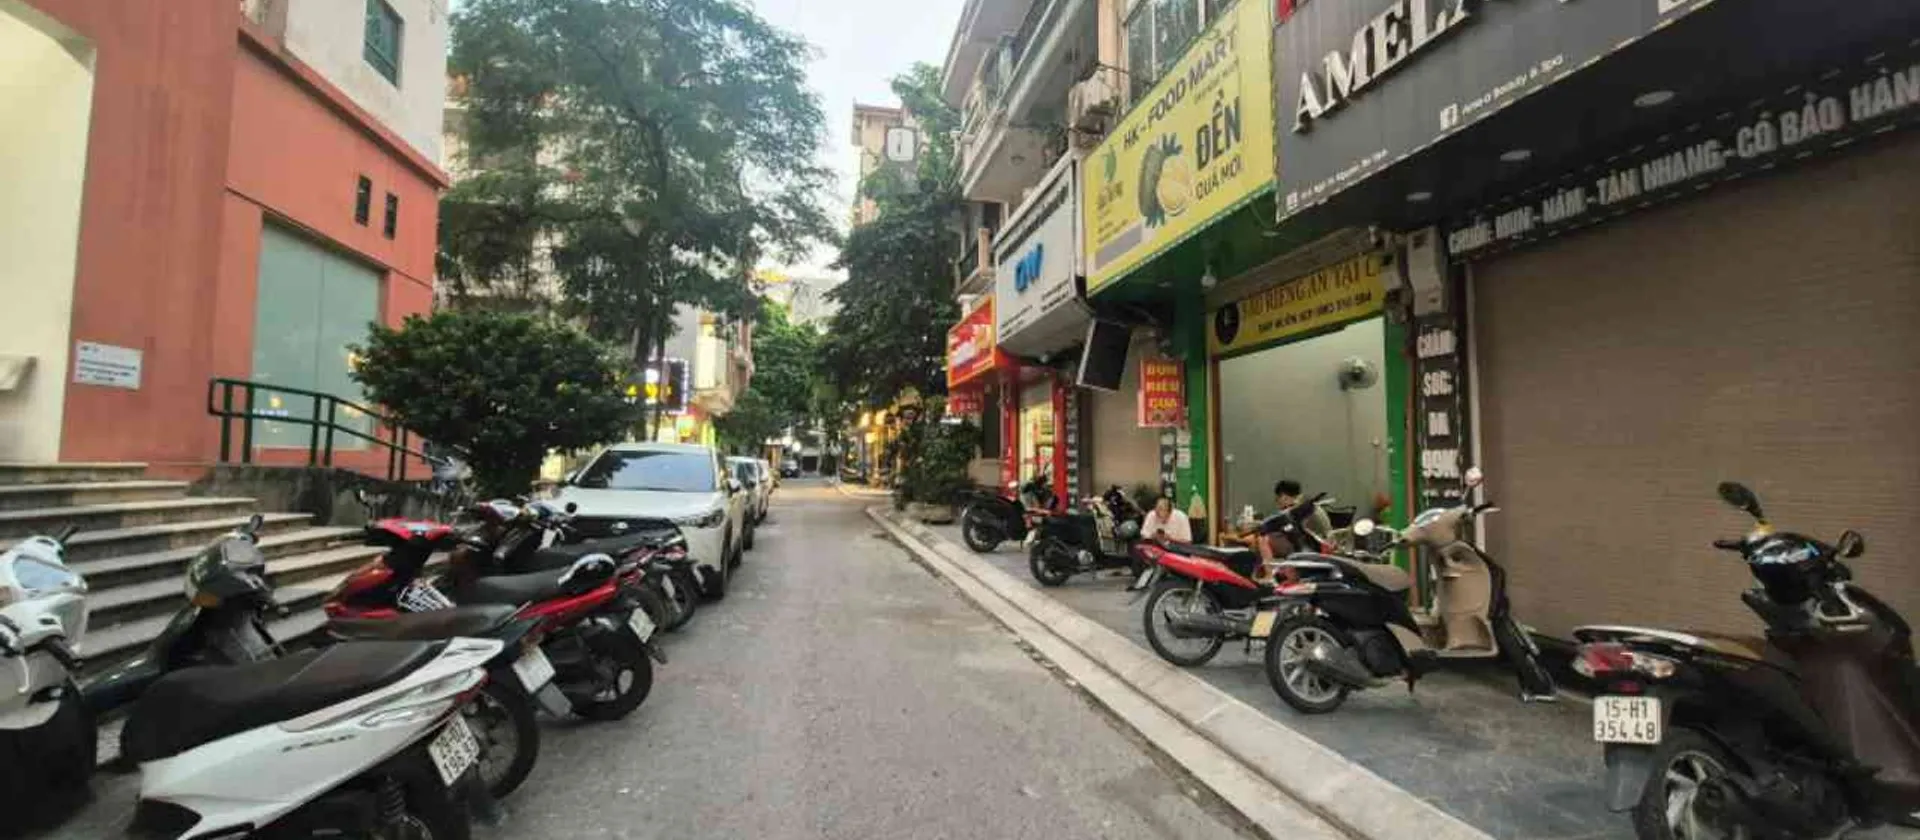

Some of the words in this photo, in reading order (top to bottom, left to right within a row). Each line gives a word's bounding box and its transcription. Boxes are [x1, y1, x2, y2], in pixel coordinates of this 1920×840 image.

[1147, 77, 1187, 130] FOOD
[1189, 25, 1237, 91] MART
[1605, 700, 1648, 719] 15-H1
